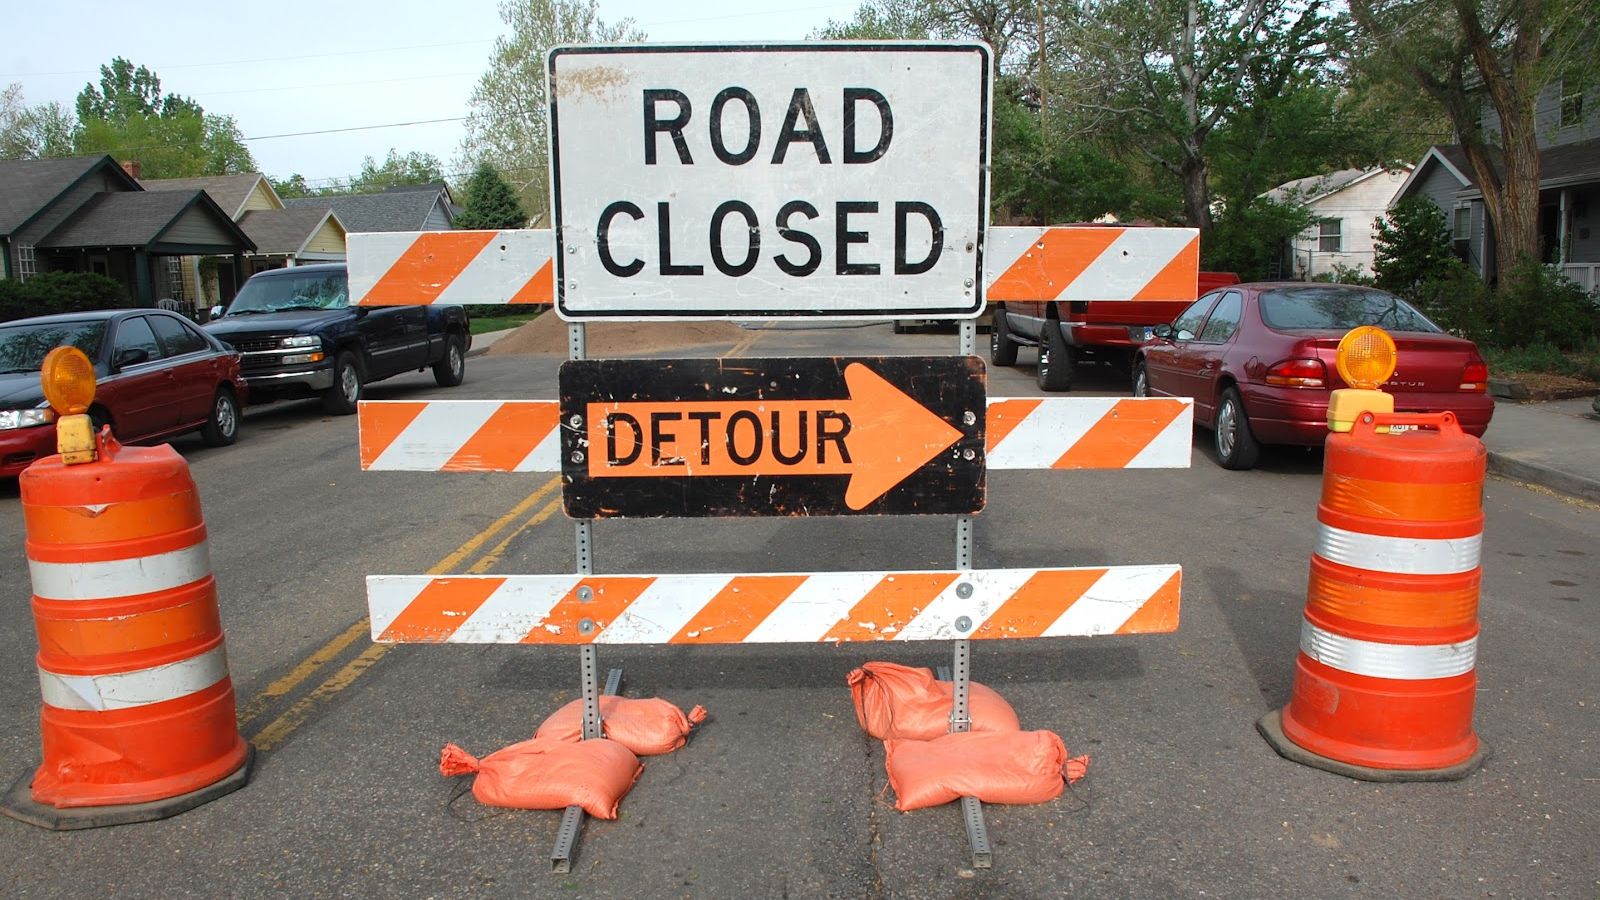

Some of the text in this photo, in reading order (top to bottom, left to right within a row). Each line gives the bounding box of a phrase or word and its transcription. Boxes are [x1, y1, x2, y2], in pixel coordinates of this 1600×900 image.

[643, 87, 893, 165] ROAD
[597, 200, 943, 277] CLOSED
[607, 411, 851, 466] DETOUR
